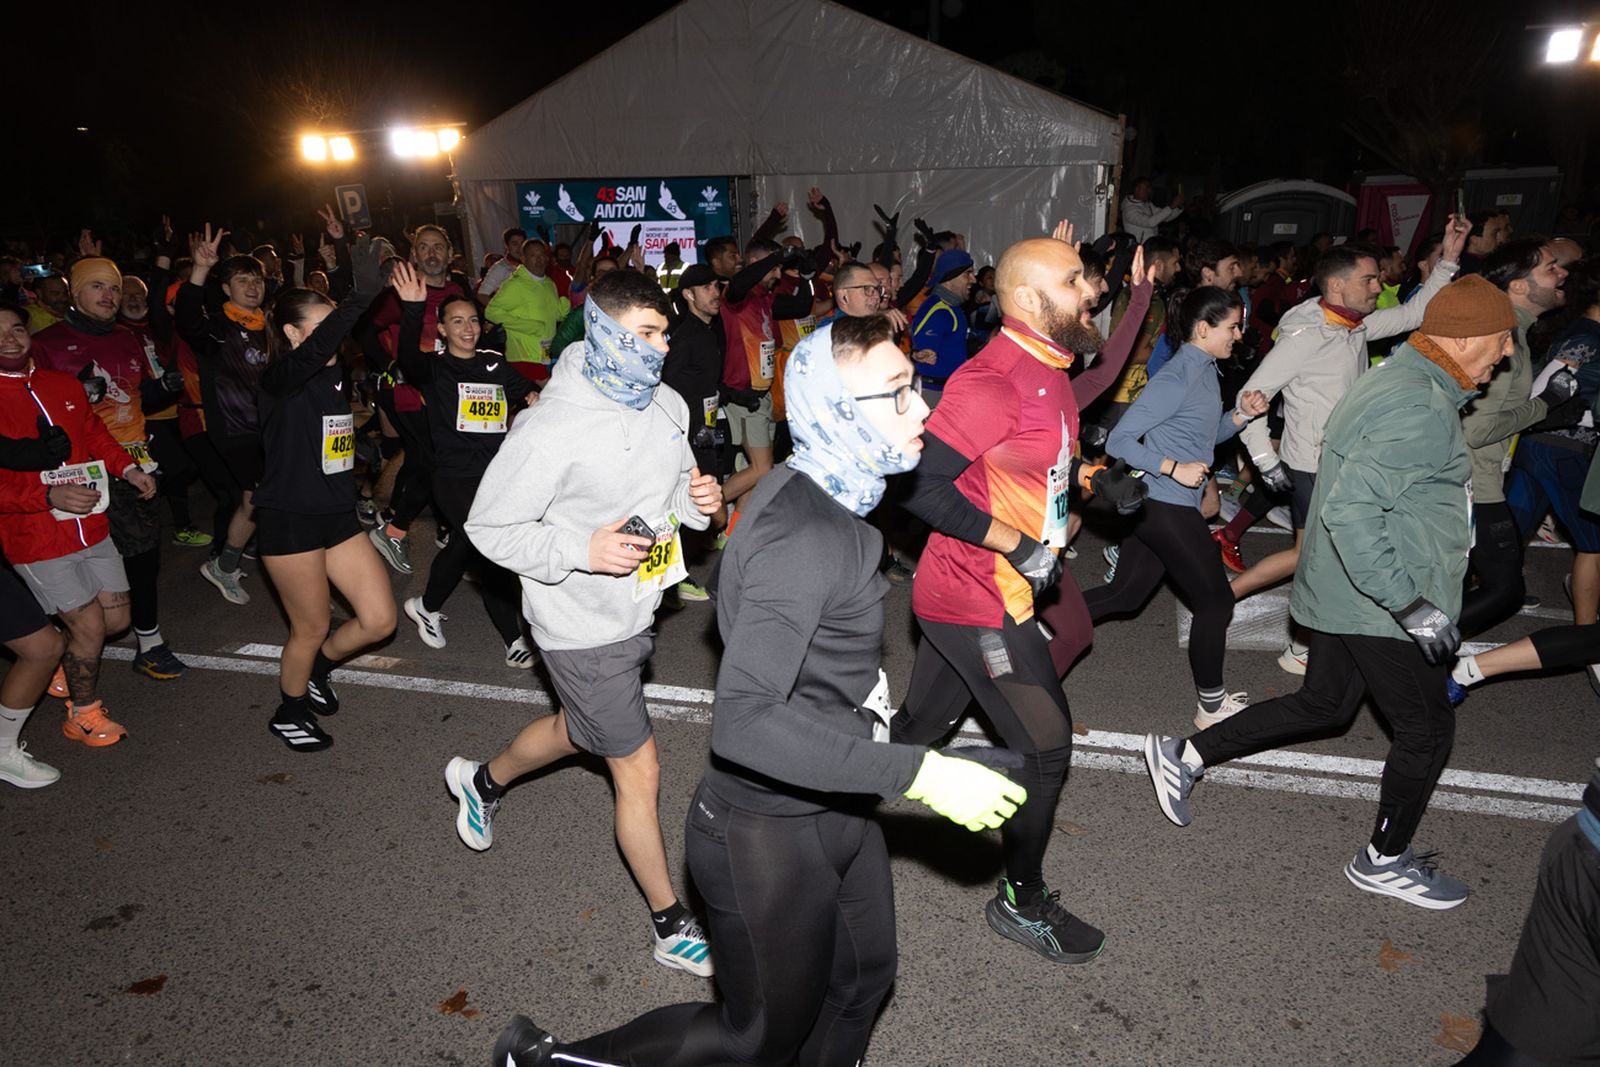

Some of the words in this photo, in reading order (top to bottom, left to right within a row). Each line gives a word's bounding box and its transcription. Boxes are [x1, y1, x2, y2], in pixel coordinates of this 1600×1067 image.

[343, 191, 361, 224] P
[565, 205, 576, 216] 43
[594, 200, 645, 218] ANTÓN
[667, 202, 677, 214] 43
[644, 238, 668, 250] SAN
[469, 401, 501, 417] 4829
